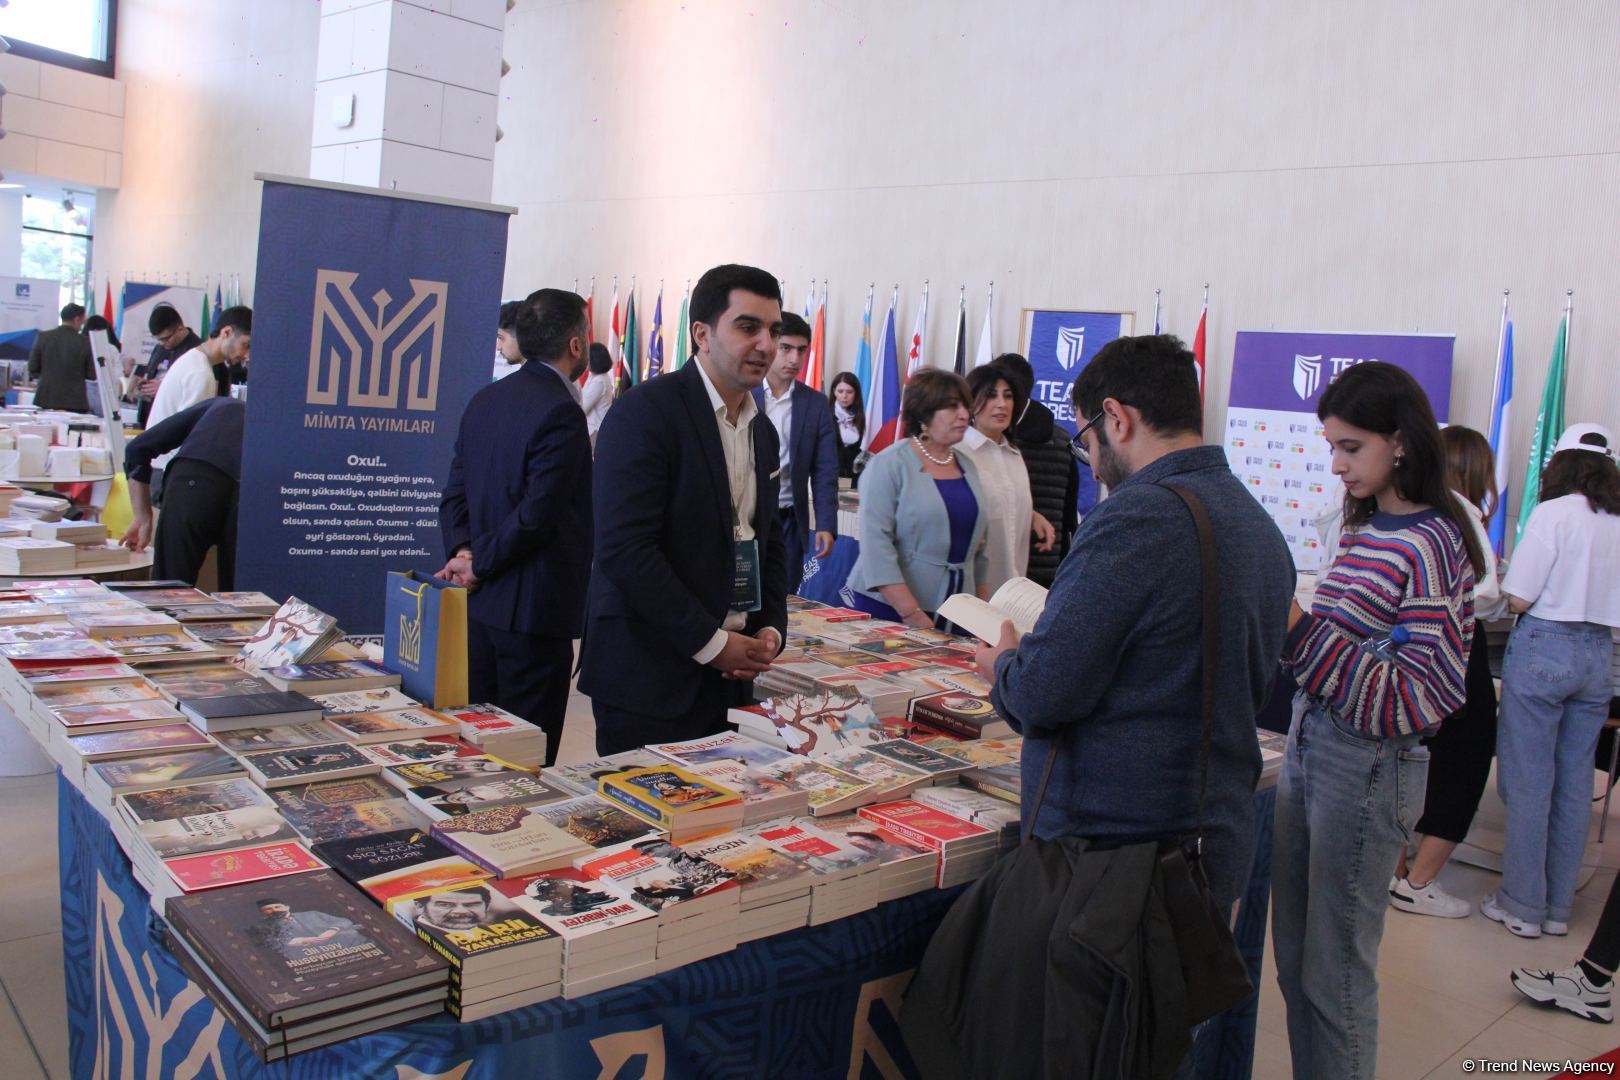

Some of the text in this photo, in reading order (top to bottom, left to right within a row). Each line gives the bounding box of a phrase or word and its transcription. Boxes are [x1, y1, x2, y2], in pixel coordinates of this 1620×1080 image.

[1036, 380, 1075, 402] TEA
[304, 411, 435, 434] MİMTA YAYIMLARI
[347, 455, 387, 467] Oxu!..
[294, 472, 434, 484] Ancaq oxuduğun ayağını yerə,
[281, 486, 309, 496] başını
[312, 487, 365, 497] yüksəkliyə,
[368, 488, 398, 498] qəlbini
[284, 502, 327, 511] bağlasın.
[357, 503, 413, 513] Oxuduqların
[415, 504, 439, 513] sənin
[283, 517, 311, 526] olsun,
[313, 518, 341, 526] səndə
[344, 518, 374, 527] qalsın.
[376, 519, 408, 527] Oxuma
[305, 532, 415, 543] əyri göstərəni, öyrədəni.
[289, 547, 323, 555] Oxuma
[330, 548, 358, 556] səndə
[360, 548, 379, 556] səni
[381, 549, 397, 557] yox
